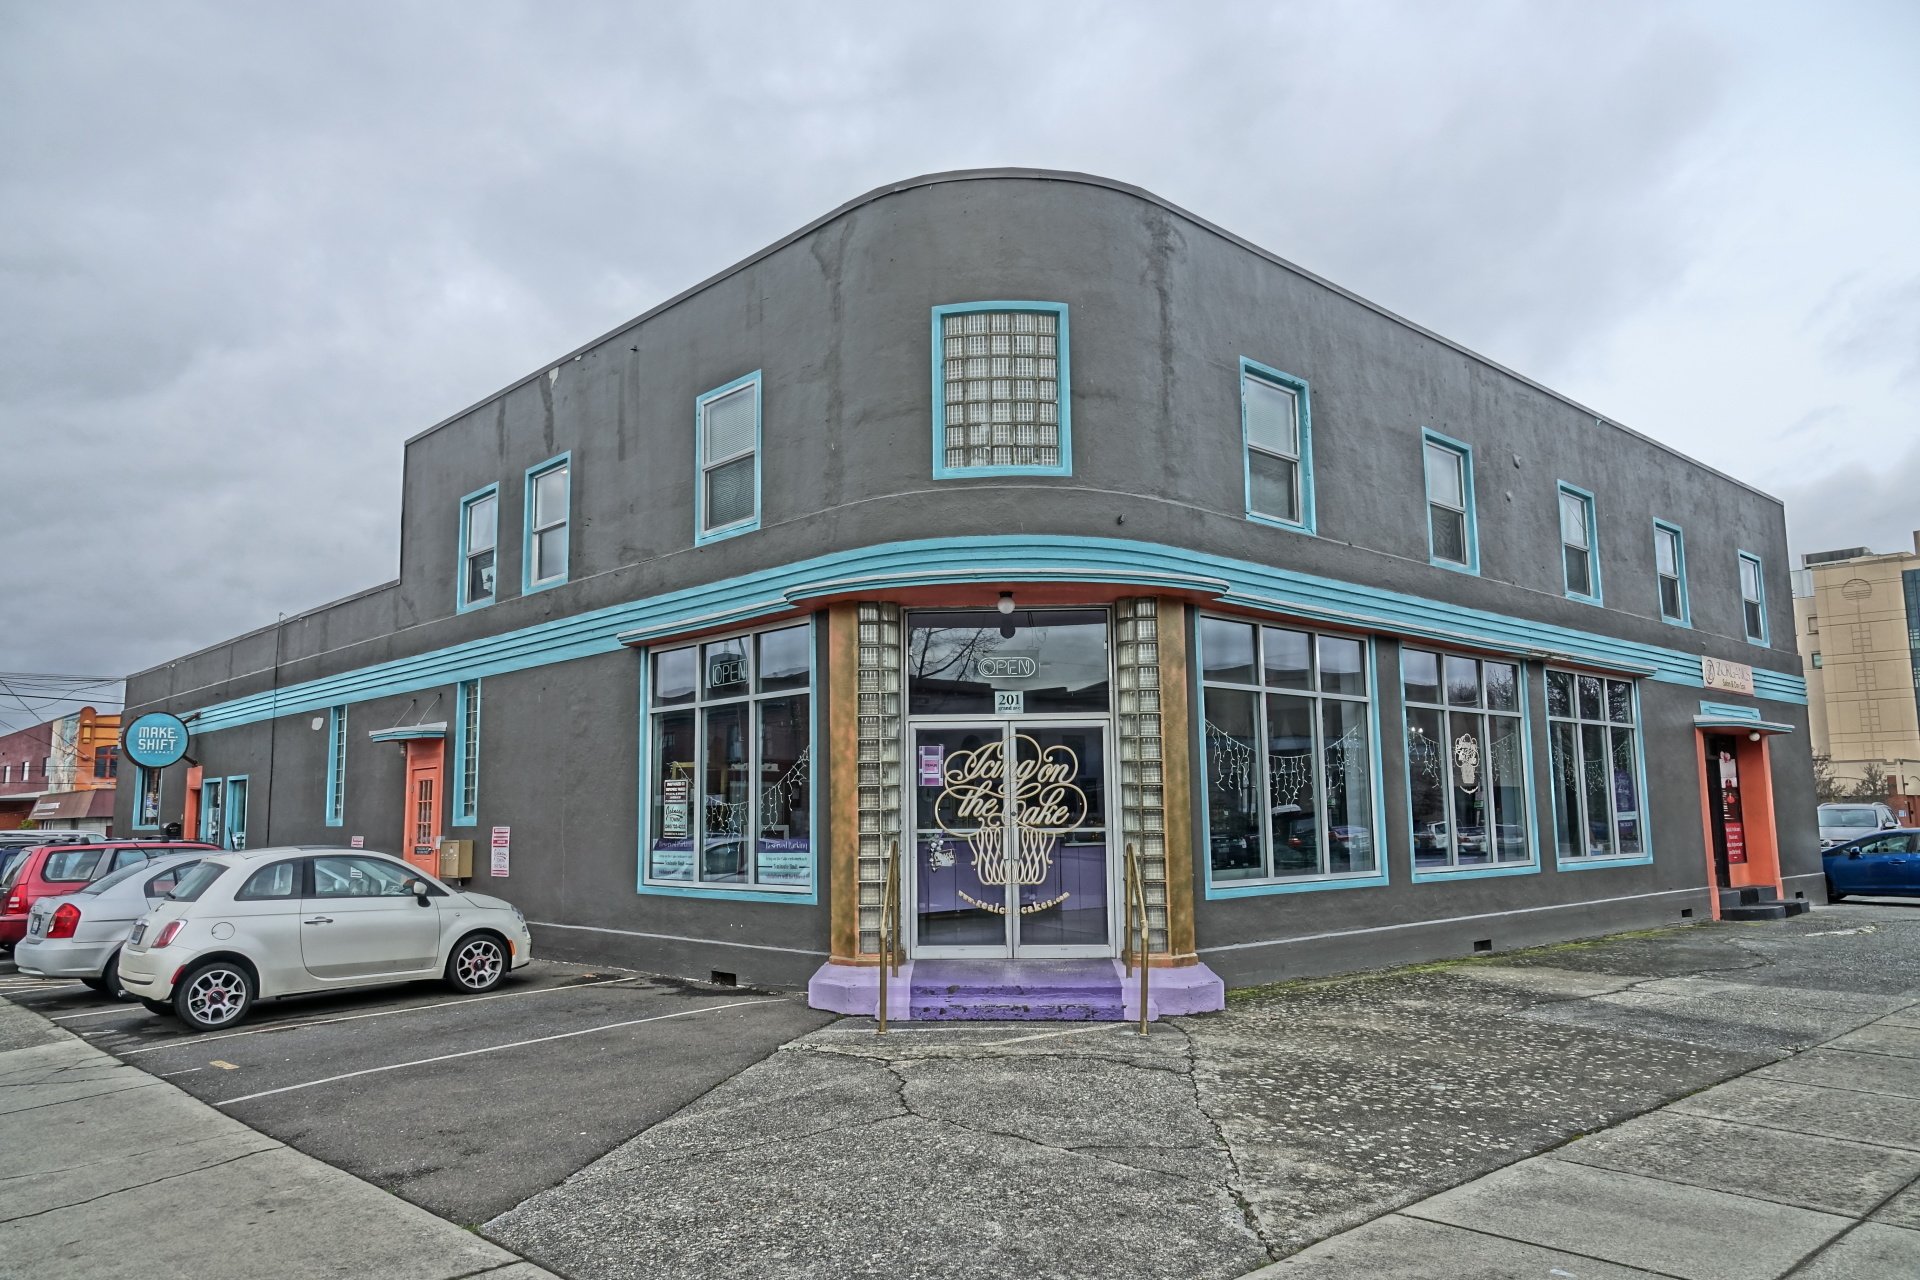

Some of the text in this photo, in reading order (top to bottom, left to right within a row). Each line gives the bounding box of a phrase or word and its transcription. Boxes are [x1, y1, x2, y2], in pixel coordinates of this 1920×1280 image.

[714, 660, 746, 684] OPEN
[981, 659, 1030, 675] OPEN
[998, 694, 1020, 706] 201
[138, 738, 176, 751] SHIFT
[944, 734, 1078, 784] Icing on
[957, 780, 1071, 827] the Cake
